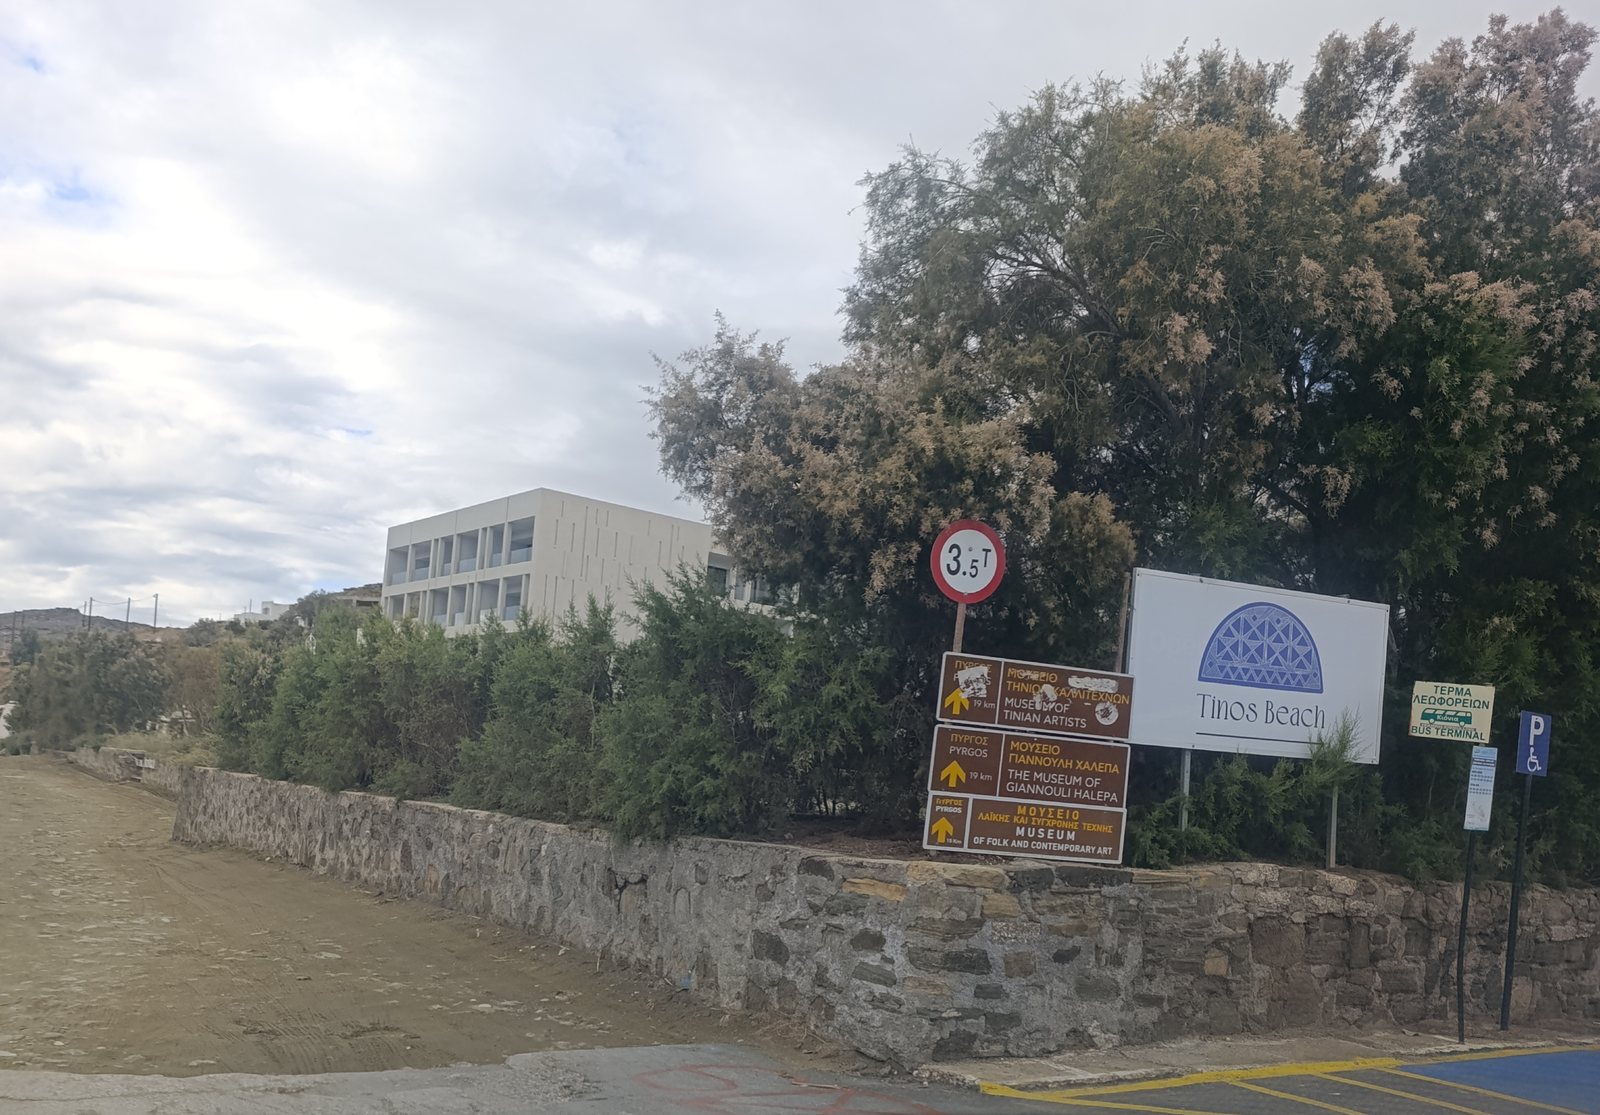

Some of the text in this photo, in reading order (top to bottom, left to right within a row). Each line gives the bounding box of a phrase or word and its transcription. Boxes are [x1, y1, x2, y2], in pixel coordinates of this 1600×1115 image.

[1433, 685, 1472, 697] ΤΕΡΜΑ
[973, 699, 996, 709] 19 km
[1054, 702, 1070, 713] OF
[1412, 694, 1490, 710] ΛΕΩΦΟΡΕΙΩΝ
[1196, 692, 1326, 729] Tinos Beach
[1003, 709, 1087, 729] TINIAN ARTISTS
[950, 733, 989, 746] ΠΥΡΓΟΣ
[1411, 725, 1432, 736] BUS
[1434, 727, 1486, 741] TERMINAL
[949, 746, 989, 758] PYRGOS
[1010, 741, 1061, 756] ΜΟΥΣΕΙΟ
[1008, 753, 1120, 774] ΓΙΑΝΝΟΥΛΗ ΧΑΛΕΠΑ
[969, 771, 993, 781] 19 km
[1007, 769, 1101, 788] THE MUSEUM OF
[1006, 781, 1118, 803] GIANNOULI HALEPA
[935, 805, 962, 814] PYRGOS
[1017, 805, 1080, 821] ΜΟΥΣΕΙΟ
[1013, 815, 1028, 824] ΚΑΙ
[1031, 817, 1079, 830] ΣΥΓΧΡΟΝΗΣ
[1082, 822, 1113, 833] ΤΕΧΝΗΣ
[1015, 826, 1076, 841] MUSEUM
[973, 836, 1113, 856] OF FOLK AND CONTEMPORARY ART
